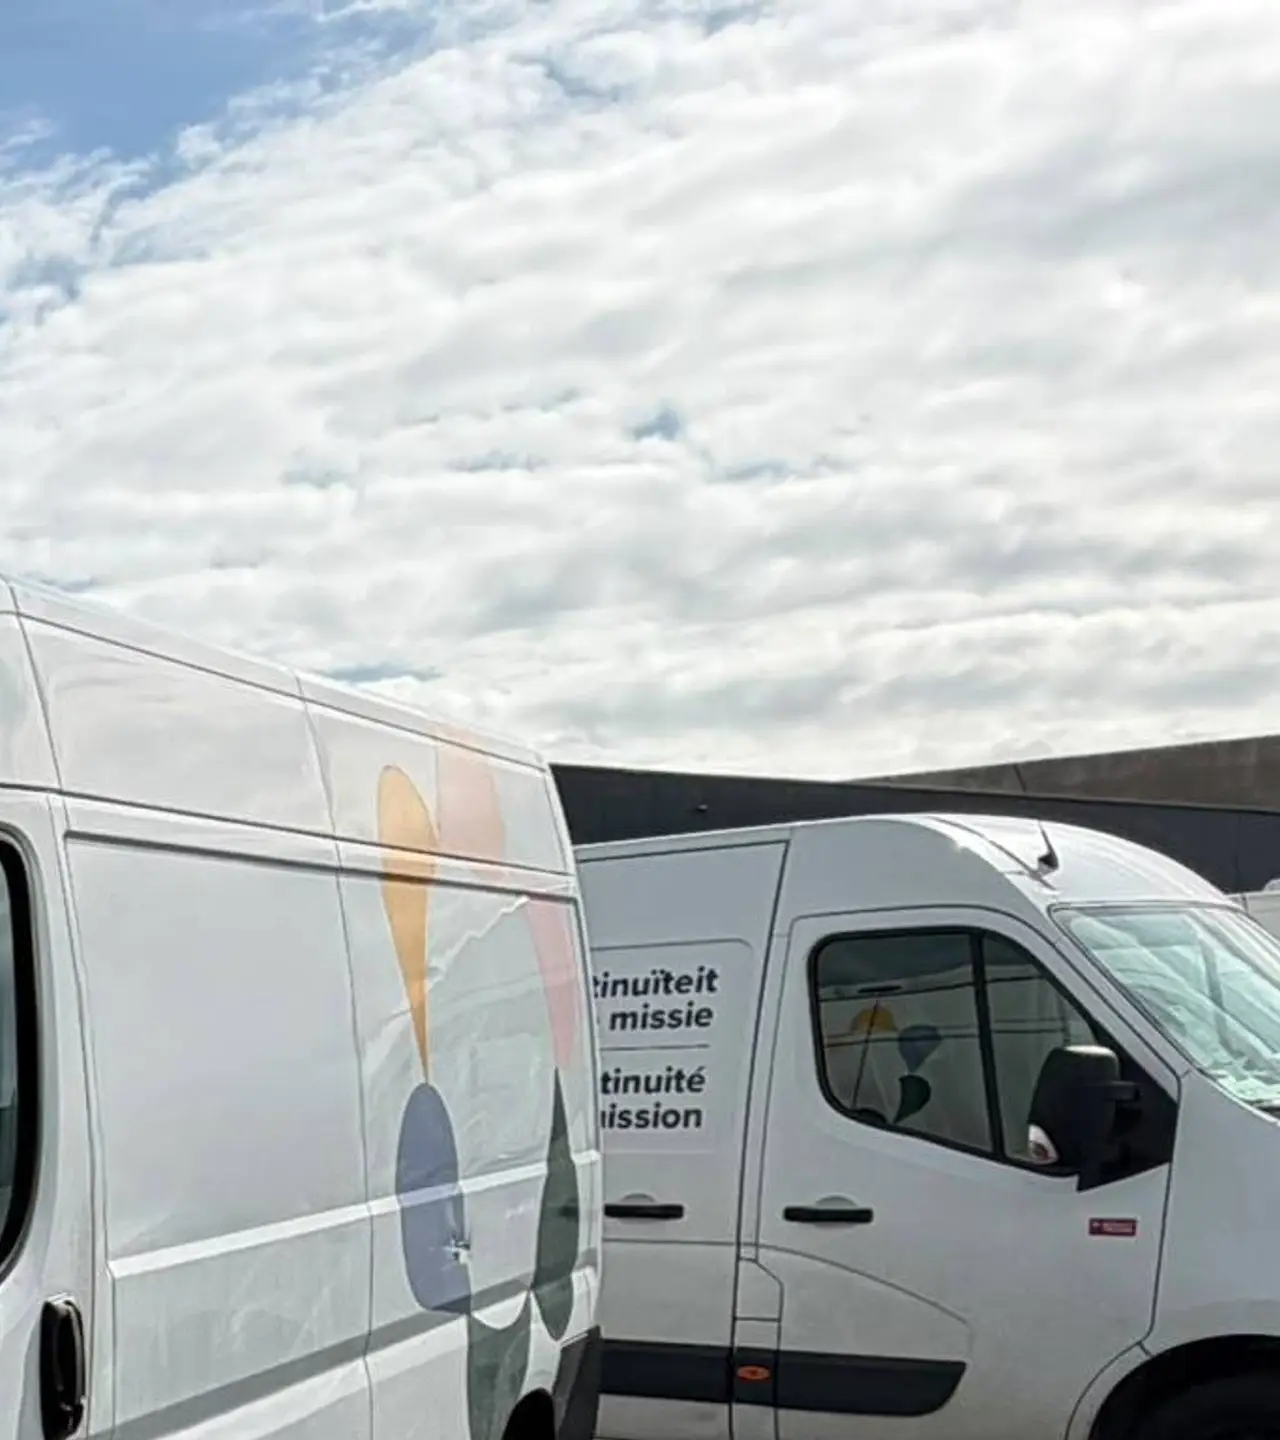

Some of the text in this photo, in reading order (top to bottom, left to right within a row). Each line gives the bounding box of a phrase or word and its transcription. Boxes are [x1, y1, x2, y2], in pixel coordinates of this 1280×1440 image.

[610, 1000, 713, 1031] missie
[601, 1065, 706, 1095] tinuité
[601, 1101, 703, 1129] ission
